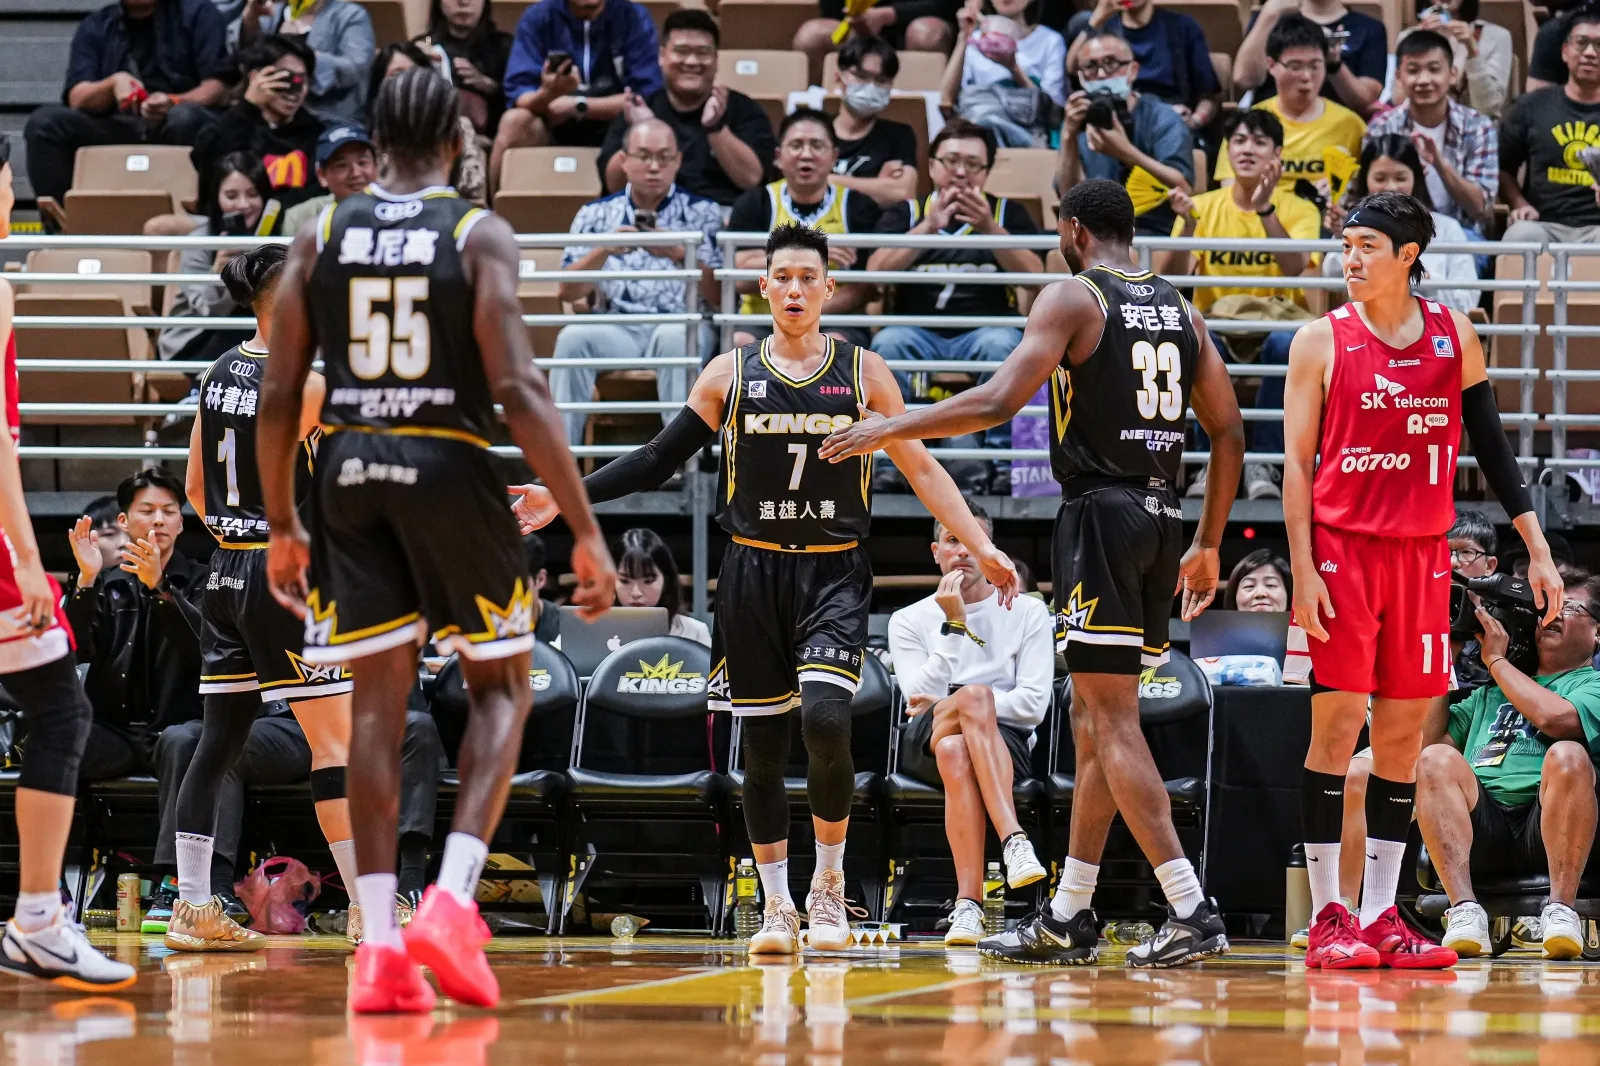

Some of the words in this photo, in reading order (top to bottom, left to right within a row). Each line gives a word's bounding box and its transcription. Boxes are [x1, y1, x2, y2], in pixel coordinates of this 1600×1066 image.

[1209, 250, 1277, 266] KING
[1120, 302, 1182, 331] 安尼奎
[349, 276, 431, 380] 55
[820, 386, 851, 395] SAMPO
[1132, 340, 1182, 421] 33
[1361, 392, 1387, 409] SK
[1394, 394, 1449, 408] telecom
[744, 413, 853, 434] KINGS
[1146, 440, 1174, 452] CITY
[217, 427, 240, 507] 1
[787, 443, 808, 490] 7
[1341, 453, 1411, 473] 00700
[759, 500, 836, 520] 遠雄人壽
[220, 517, 271, 530] TAIPE
[1421, 633, 1449, 674] 11
[617, 675, 706, 694] KINGS
